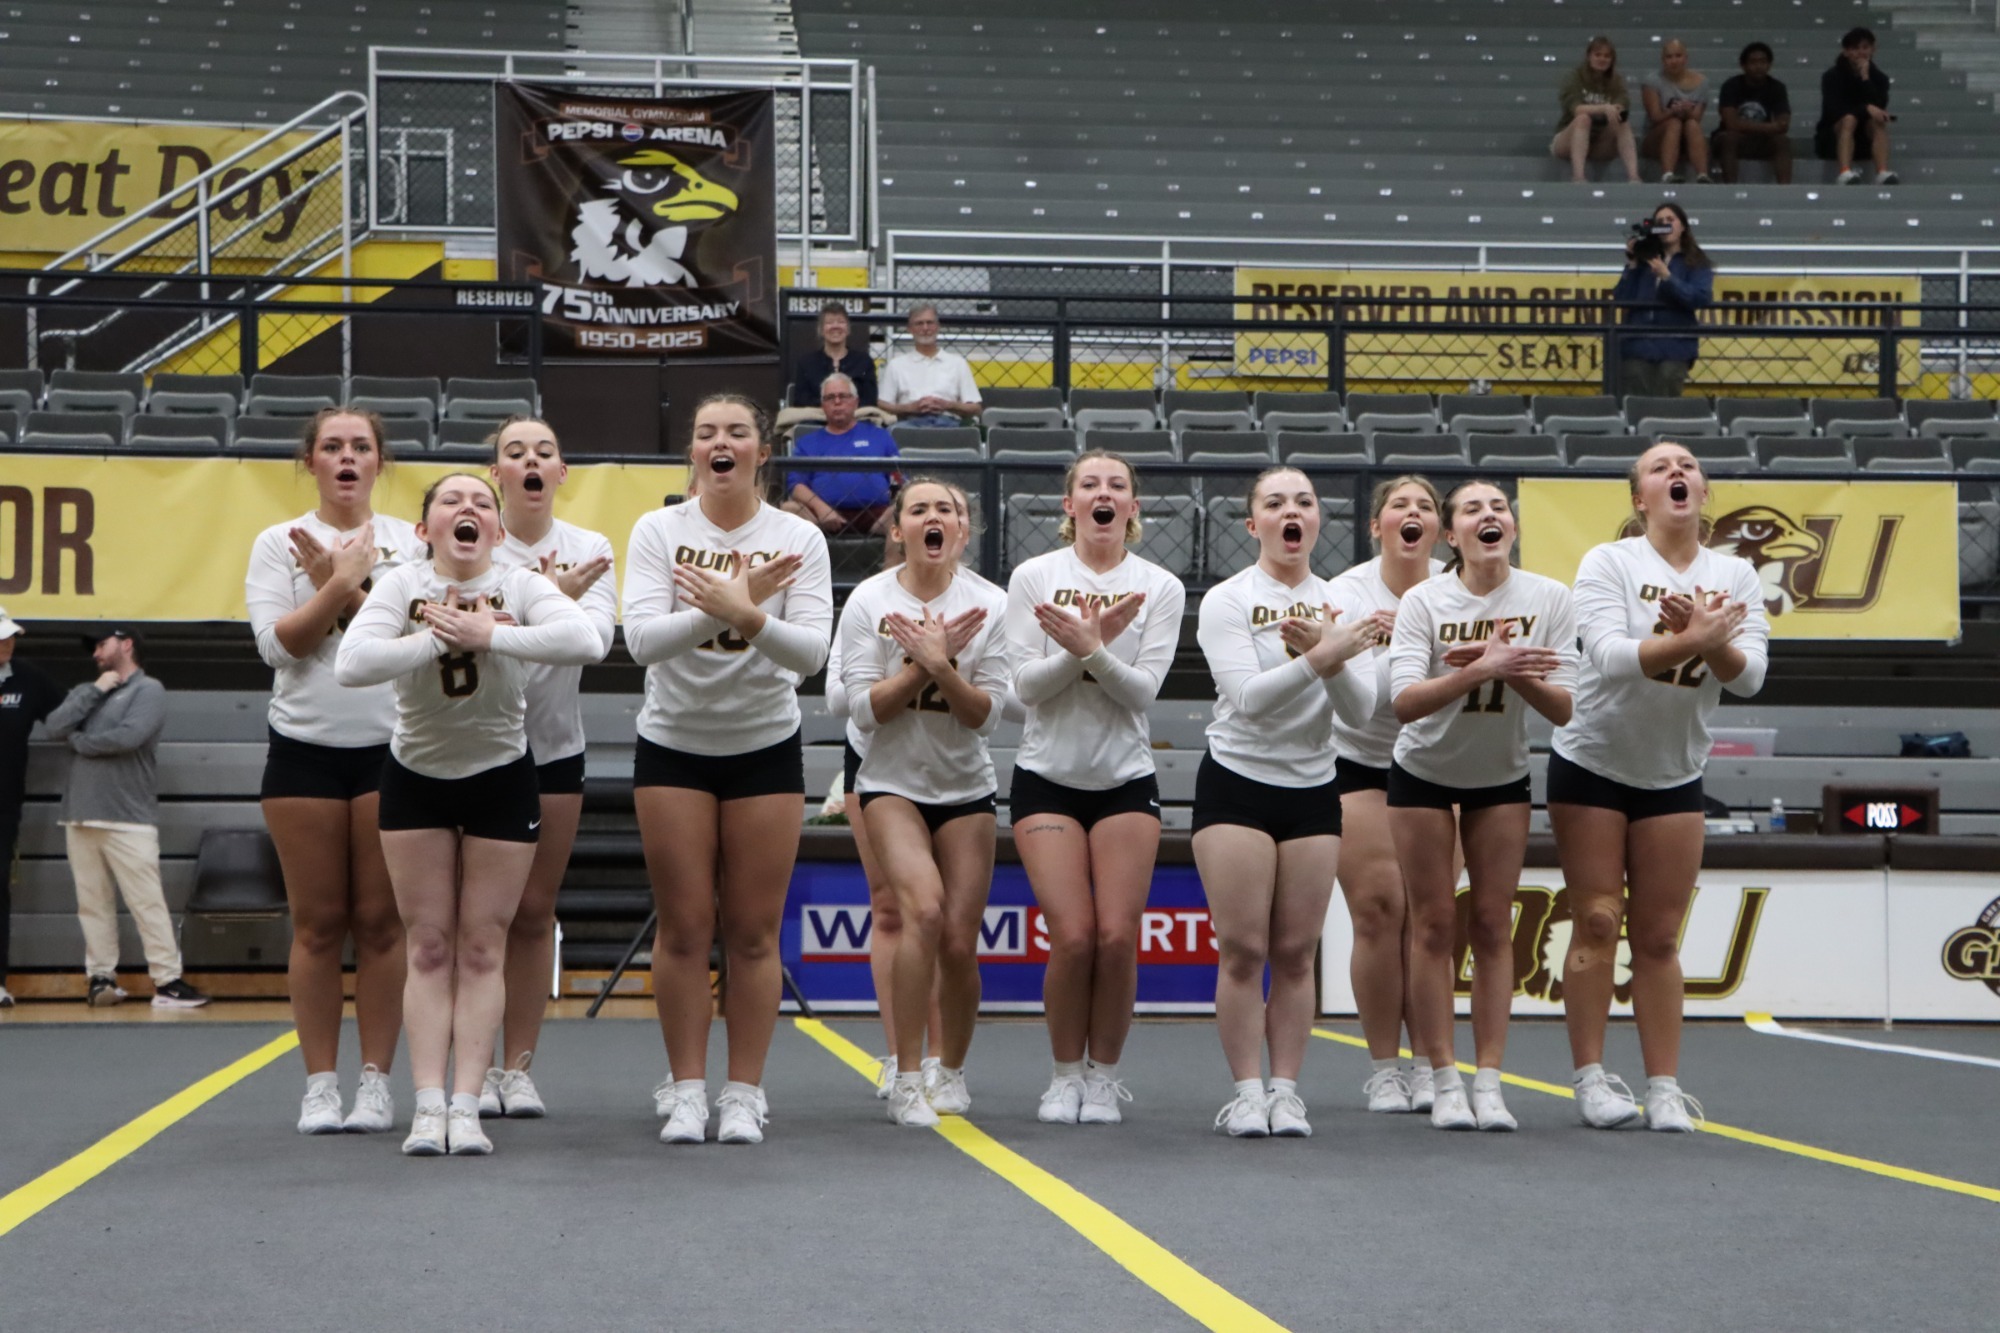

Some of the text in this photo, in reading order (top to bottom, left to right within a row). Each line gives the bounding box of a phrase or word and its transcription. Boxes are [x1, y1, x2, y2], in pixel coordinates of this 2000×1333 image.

[564, 105, 706, 122] MEMORIAL GYMNASIUM
[547, 121, 727, 148] PEPSI ARENA
[0, 145, 319, 243] eat Day
[456, 290, 534, 307] RESERVED
[541, 283, 740, 325] 75th ANNIVERSARY
[1445, 286, 1518, 325] AND
[579, 329, 703, 349] 1950-2025
[1249, 347, 1317, 366] PEPSI
[1498, 343, 1598, 370] SEATI
[0, 485, 95, 595] OR
[438, 650, 479, 698] 8
[1866, 802, 1899, 829] POSS
[807, 909, 1020, 950] WM
